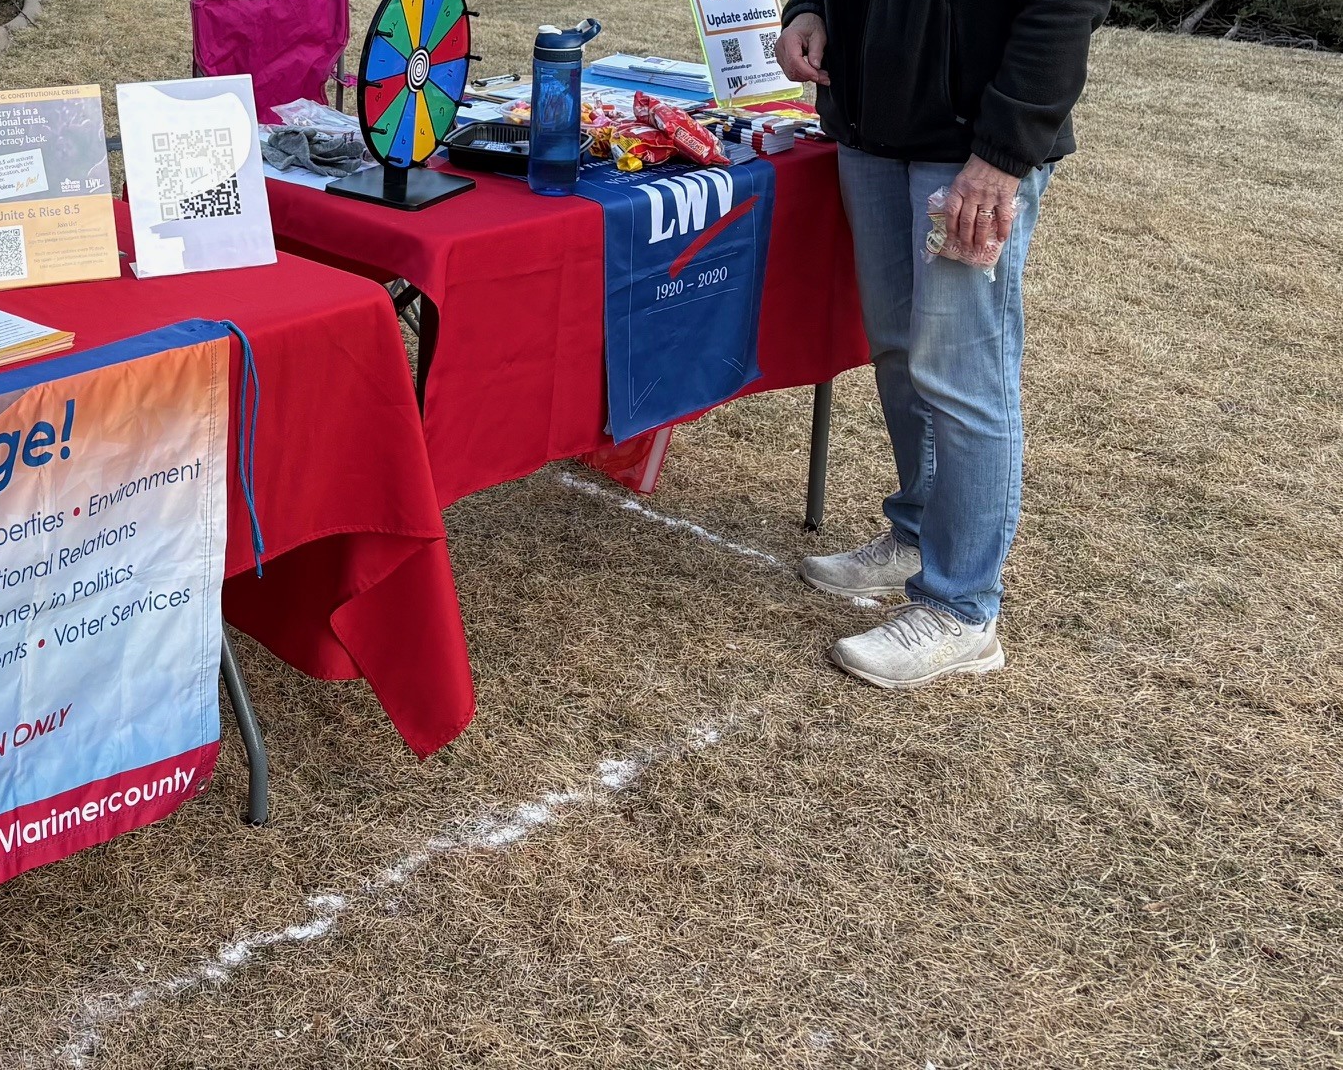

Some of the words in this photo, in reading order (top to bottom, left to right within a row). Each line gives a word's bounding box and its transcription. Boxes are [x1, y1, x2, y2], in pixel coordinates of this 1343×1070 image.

[707, 13, 740, 28] Update
[743, 8, 776, 20] address
[727, 76, 742, 89] LWV
[8, 91, 61, 99] CONSTITUTIONAL
[22, 107, 32, 115] in
[23, 116, 48, 125] crisis.
[7, 127, 25, 135] take
[26, 134, 47, 143] back.
[16, 155, 34, 163] activate
[185, 166, 204, 178] LWV
[85, 178, 101, 188] LWV
[28, 209, 36, 218] &
[40, 207, 61, 217] Rise
[64, 204, 80, 215] 8.5
[631, 168, 734, 244] LWV
[656, 280, 683, 301] 1920
[698, 266, 728, 288] 2020
[88, 458, 202, 518] Environment
[58, 518, 137, 571] Relations
[49, 593, 66, 611] in
[70, 562, 133, 607] Politics
[53, 616, 107, 648] Voter
[110, 585, 190, 627] Services
[12, 702, 73, 750] ONLY
